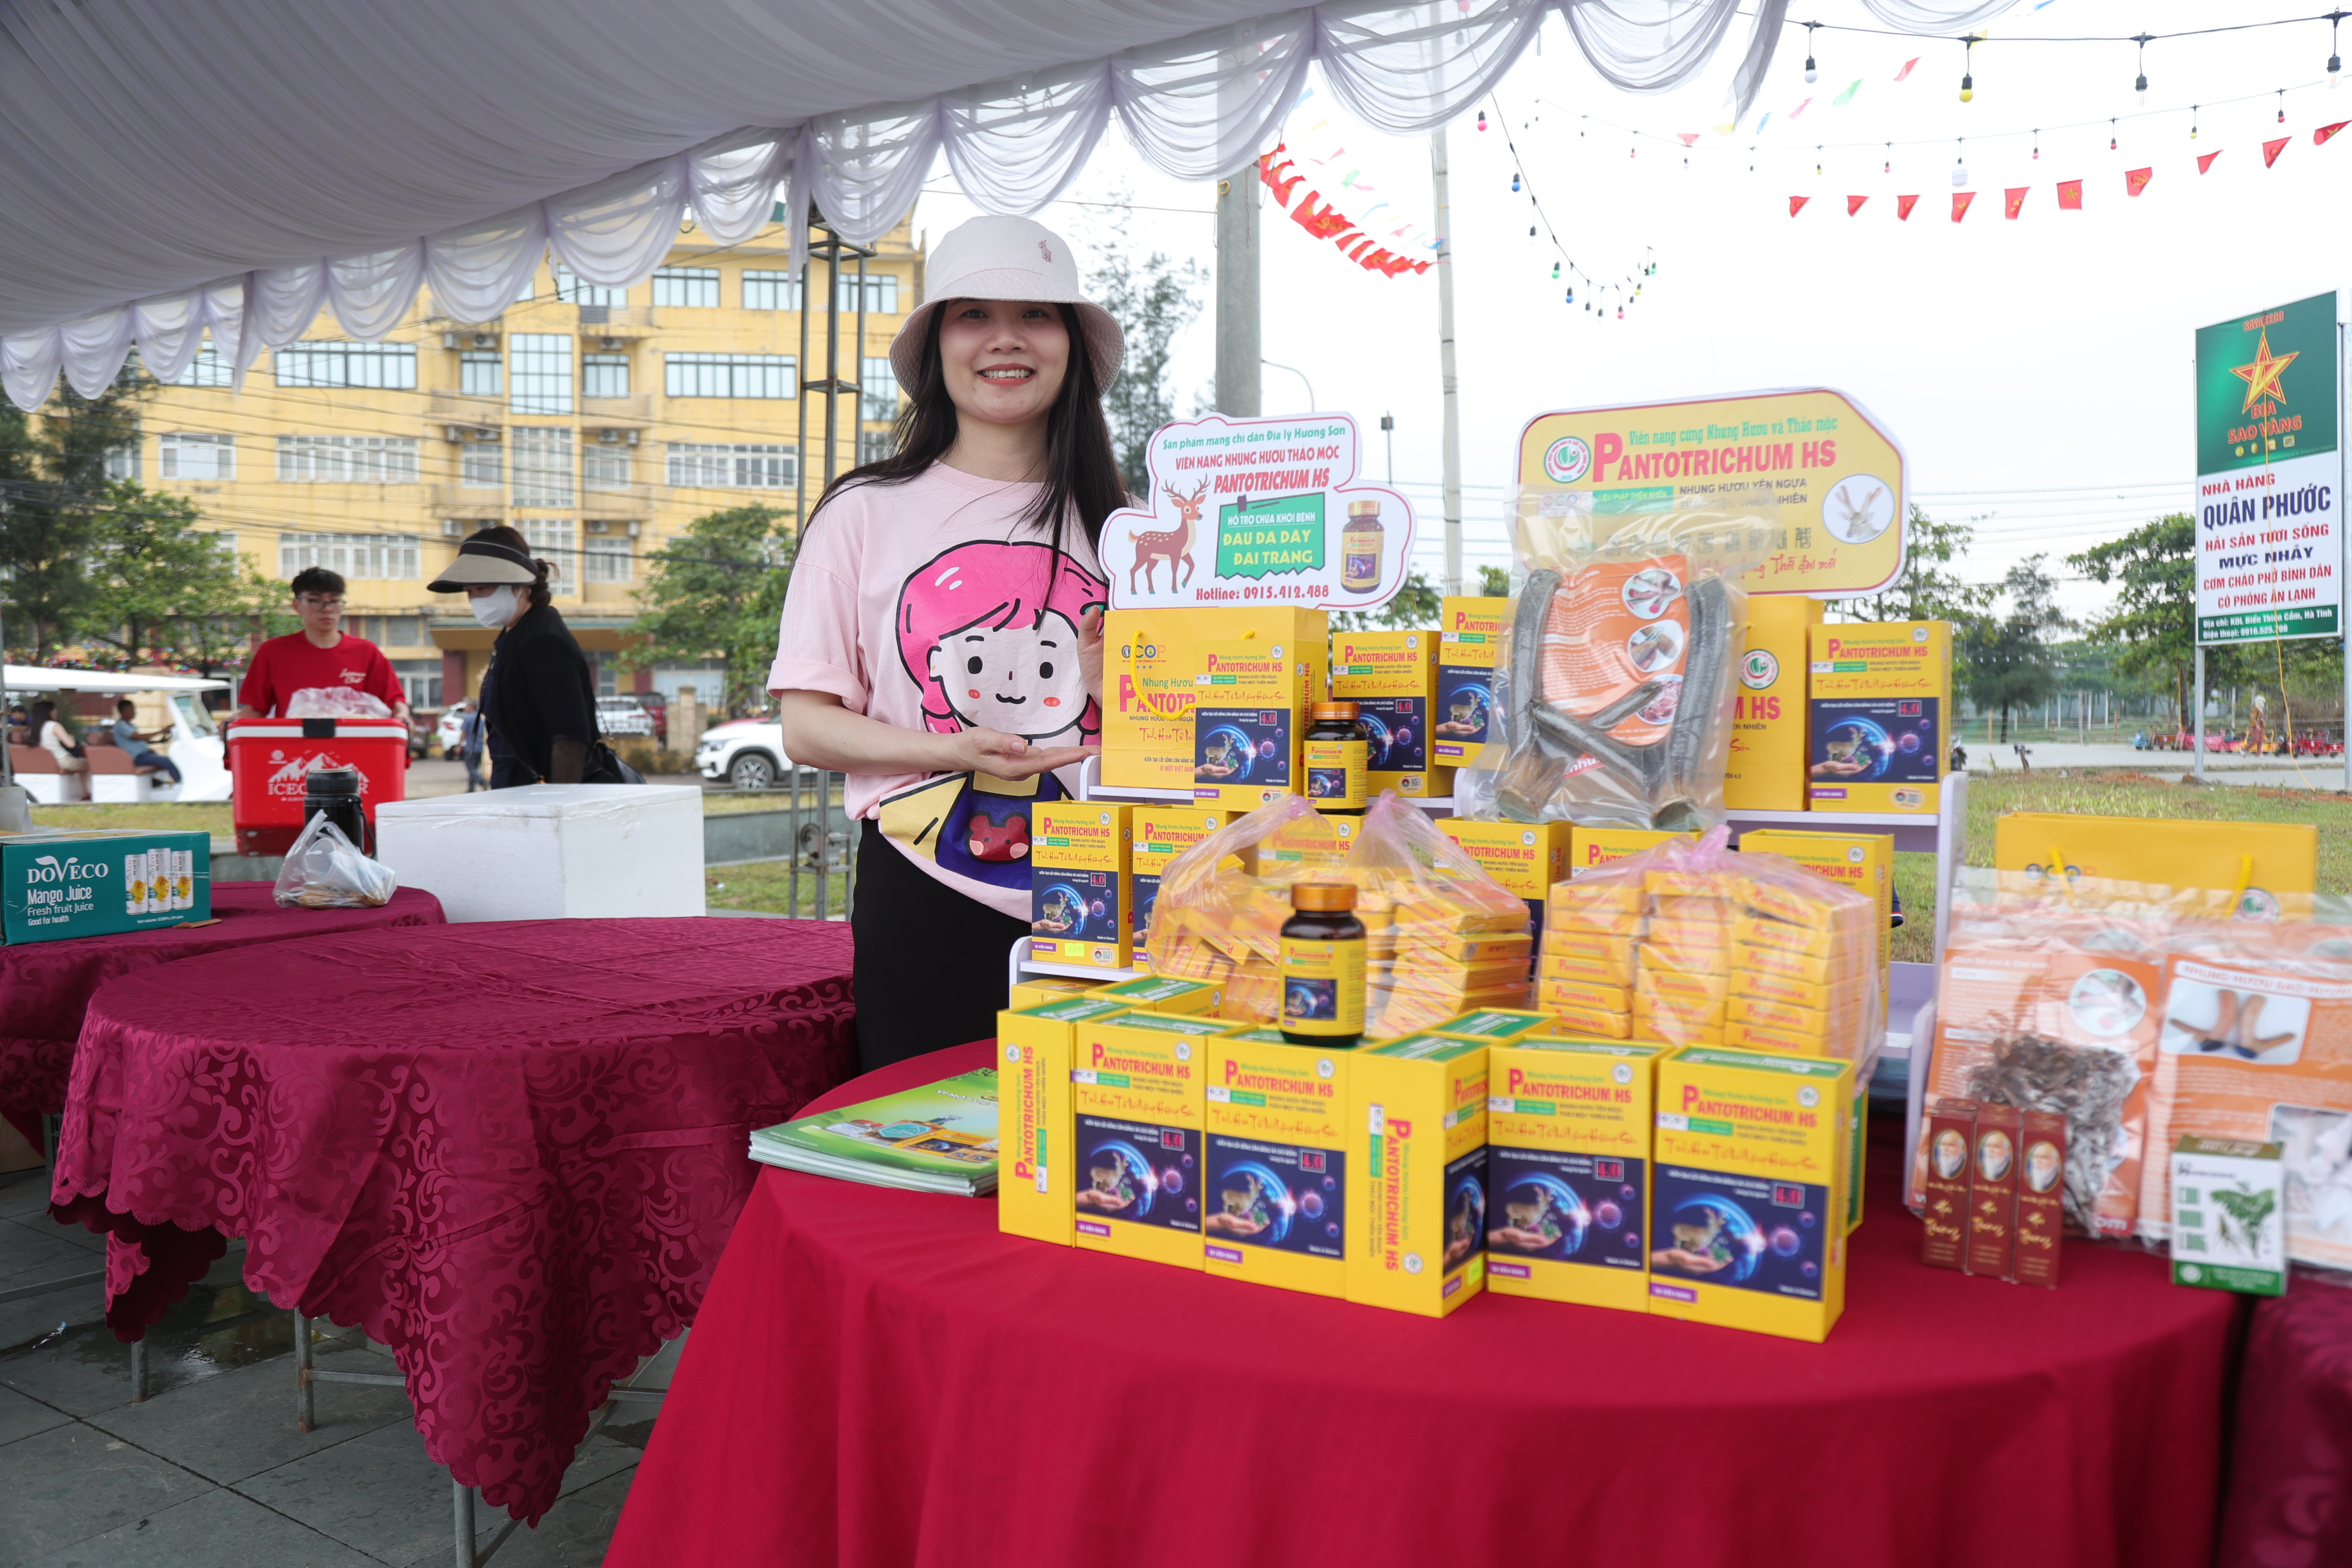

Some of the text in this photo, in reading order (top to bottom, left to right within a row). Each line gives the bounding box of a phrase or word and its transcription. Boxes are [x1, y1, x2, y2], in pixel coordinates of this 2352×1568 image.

[2251, 400, 2277, 419] BIA
[1206, 436, 1230, 447] mang
[1266, 430, 1281, 441] Địa
[1328, 425, 1345, 436] Sơn
[1629, 430, 1649, 446] Viên
[1653, 430, 1677, 446] nang
[1707, 424, 1740, 442] Nhung
[2228, 414, 2302, 444] SAO VÀNG
[1176, 455, 1195, 470] VIÊN
[1197, 454, 1223, 468] NANG
[1225, 451, 1256, 466] NHUNG
[1593, 432, 1794, 483] PANTOTRICHUM
[1801, 439, 1837, 469] HS
[1214, 468, 1330, 494] PANTOTRICHUM HS
[1680, 484, 1716, 495] NHUNG
[1776, 478, 1808, 490] NGỰA
[2202, 473, 2275, 496] NHÀ HÀNG
[2204, 482, 2331, 531] QUÂN PHƯỚC
[1223, 531, 1253, 546] ĐAU
[1256, 531, 1277, 545] DẠ
[2206, 534, 2225, 552] HẢI
[2292, 521, 2329, 540] SỐNG
[1233, 551, 1259, 566] ĐẠI
[2219, 553, 2258, 570] MỰC
[2281, 567, 2306, 582] BÌNH
[2309, 563, 2331, 579] DÂN
[1196, 585, 1329, 600] Hotline: 0915.412.488
[2234, 592, 2267, 607] PHÒNG
[2288, 587, 2315, 603] LẠNH
[2304, 609, 2314, 619] Hà
[1345, 645, 1417, 663] PANTOTRICHUM HS
[1828, 638, 1928, 659] PANTOTRICHUM HS
[1208, 654, 1283, 672] PANTOTRICHUM HS
[1142, 677, 1193, 689] Nhung Hươu
[1397, 701, 1412, 712] 4.0
[1752, 696, 1781, 720] HS
[1900, 703, 1920, 716] 4.0
[1261, 713, 1276, 724] 4.0
[1044, 817, 1110, 837] PANTOTRICHUM HS
[27, 855, 109, 884] DOVECO
[1092, 876, 1105, 885] 4.0
[27, 884, 92, 906] Mango Juice
[28, 906, 52, 916] Fresh
[54, 904, 73, 913] fruit
[52, 914, 70, 923] health
[1092, 1043, 1191, 1080] PANTOTRICHUM HS
[1224, 1060, 1334, 1097] PANTOTRICHUM HS
[1508, 1068, 1633, 1103] PANTOTRICHUM HS
[1015, 1046, 1034, 1180] PANTOTRICHUM HS
[1682, 1084, 1818, 1128] PANTOTRICHUM HS
[1301, 1152, 1324, 1170] 4.0
[1385, 1119, 1412, 1272] PANTOTRICHUM HS
